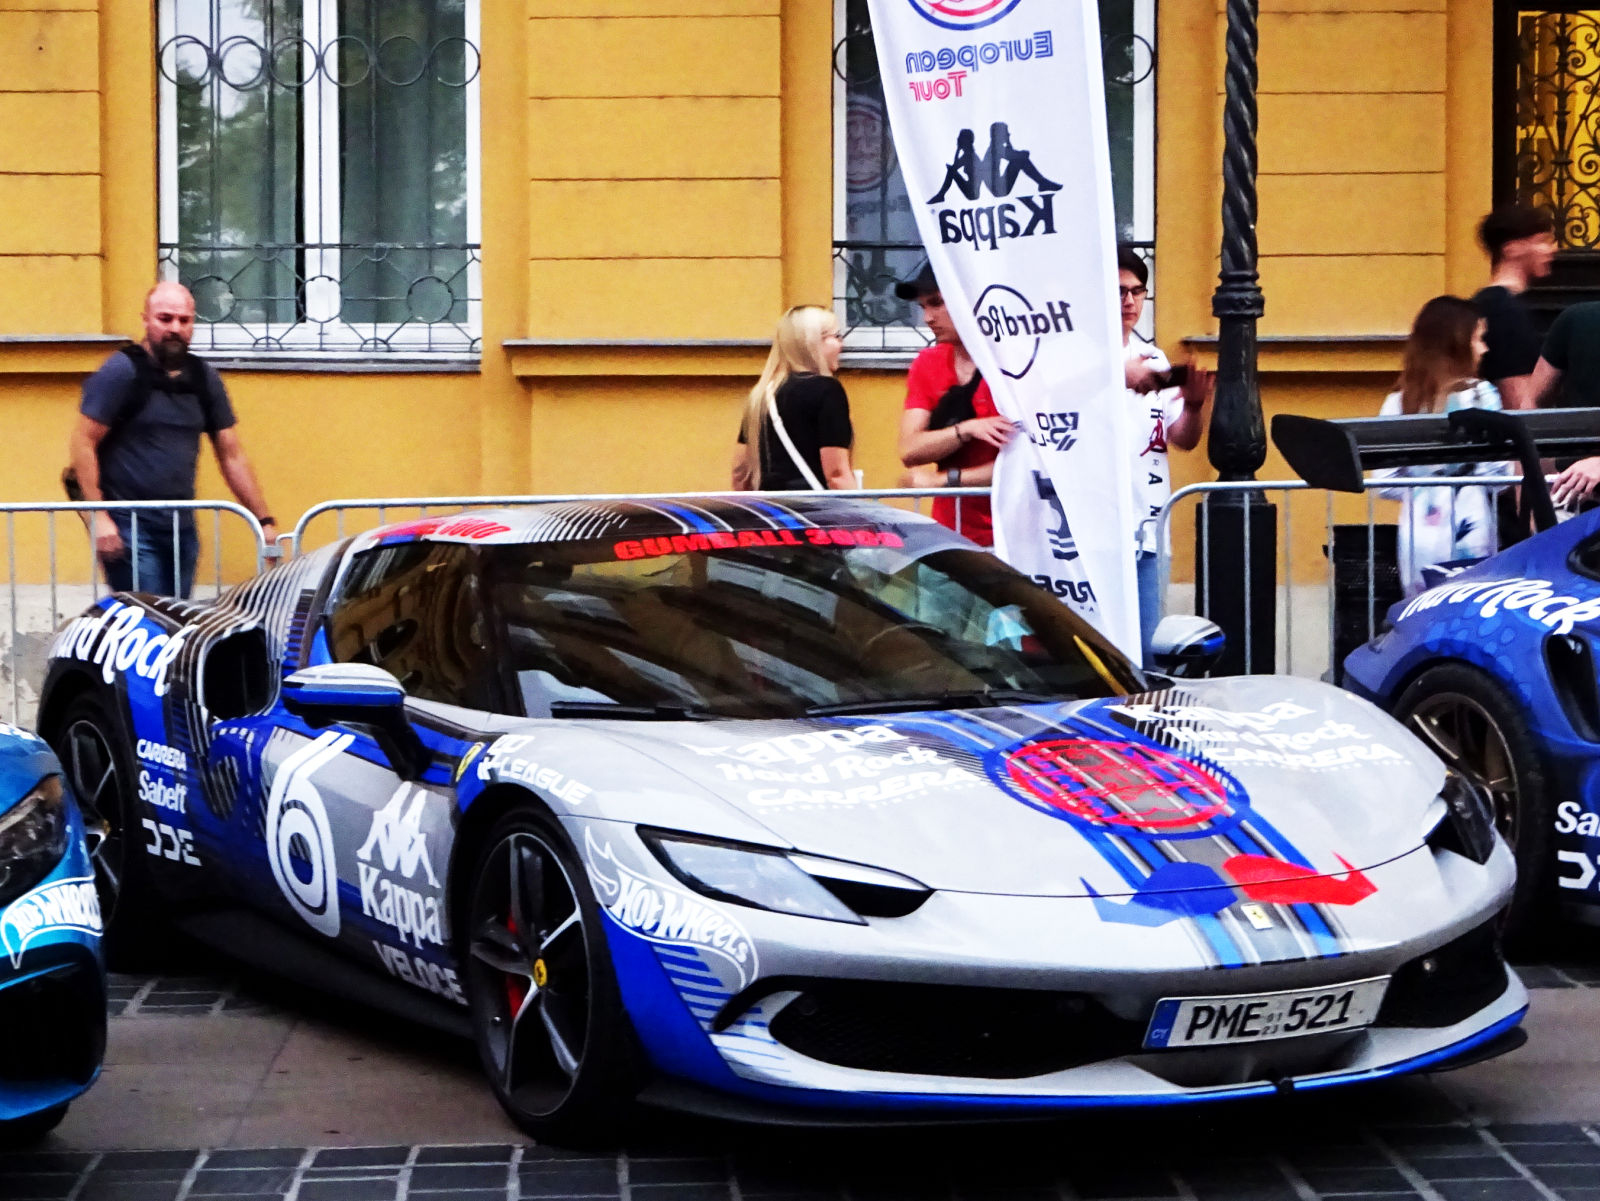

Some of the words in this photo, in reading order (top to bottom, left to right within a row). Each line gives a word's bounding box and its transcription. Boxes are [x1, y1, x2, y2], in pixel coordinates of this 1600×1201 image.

[613, 529, 803, 560] GUMBALL
[804, 528, 904, 549] 3000
[136, 738, 187, 771] CARRERA
[1266, 719, 1374, 751] Rock
[716, 762, 830, 785] Hard
[829, 745, 955, 779] Rock
[1203, 743, 1406, 768] CARRERA
[138, 770, 188, 814] Sabelt
[748, 767, 983, 806] CARRERA
[266, 730, 356, 937] 6
[1554, 801, 1600, 837] Sa
[356, 862, 445, 950] Kappa
[372, 940, 469, 1006] VELOCE
[1184, 1002, 1268, 1041] PME
[1284, 990, 1355, 1032] 521
